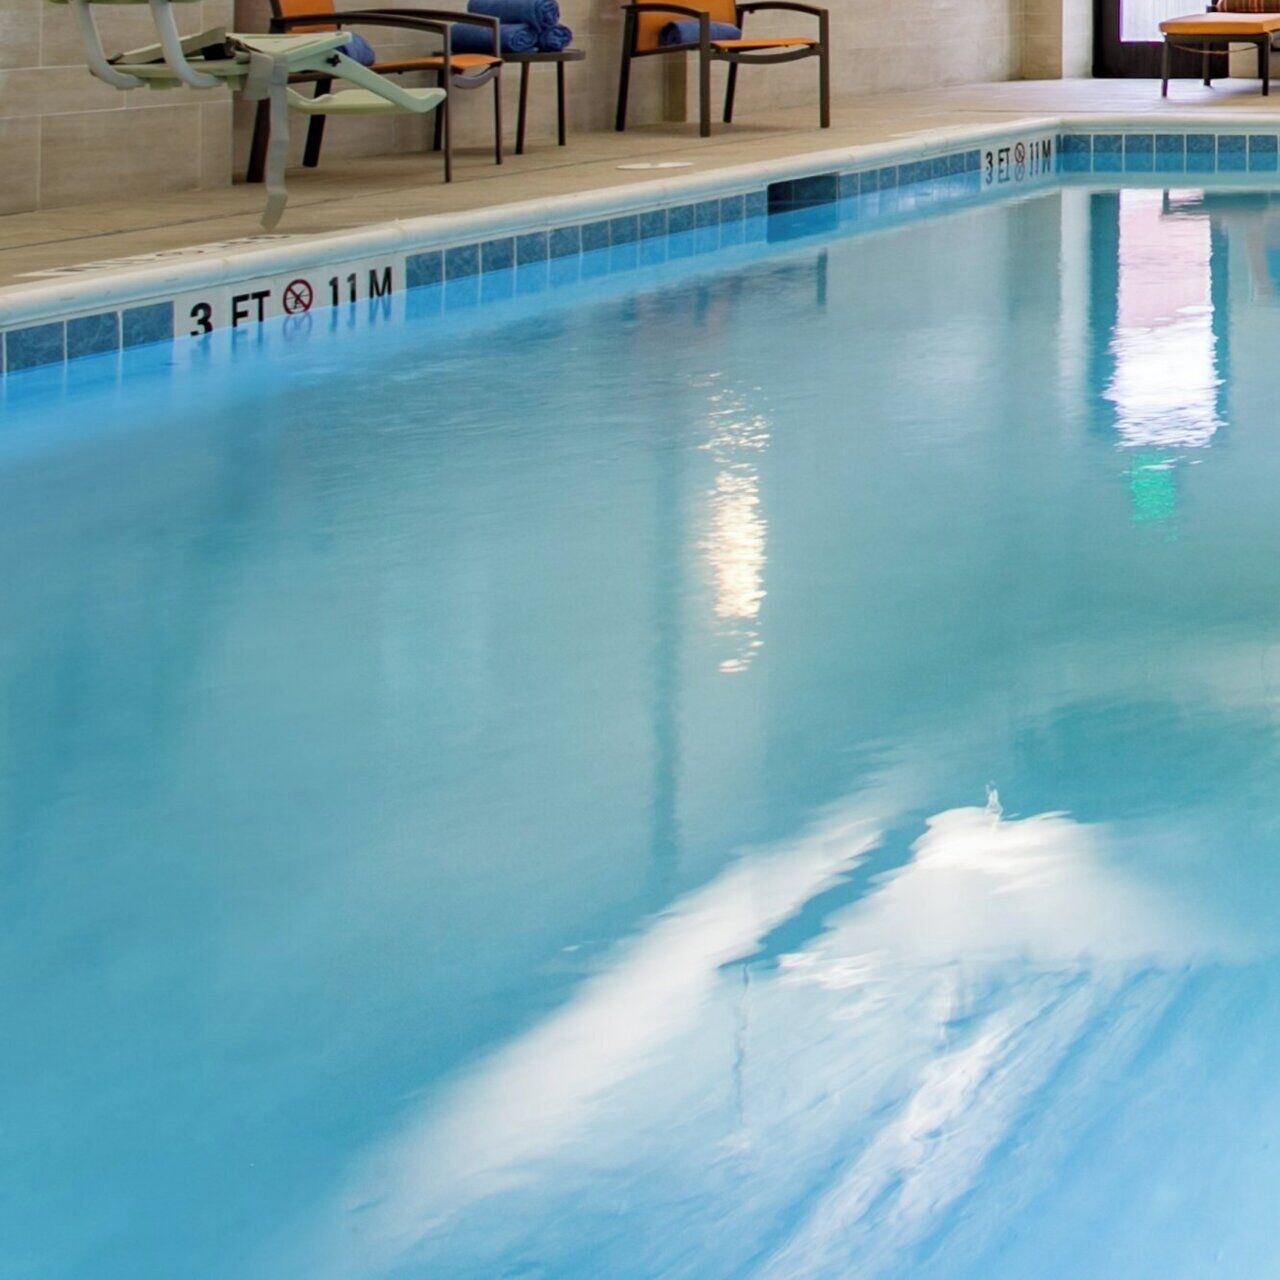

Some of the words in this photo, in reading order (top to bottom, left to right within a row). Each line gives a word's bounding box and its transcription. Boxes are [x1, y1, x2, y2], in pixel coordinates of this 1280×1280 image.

[998, 147, 1011, 167] FT
[190, 302, 214, 337] 3
[231, 289, 271, 328] FT
